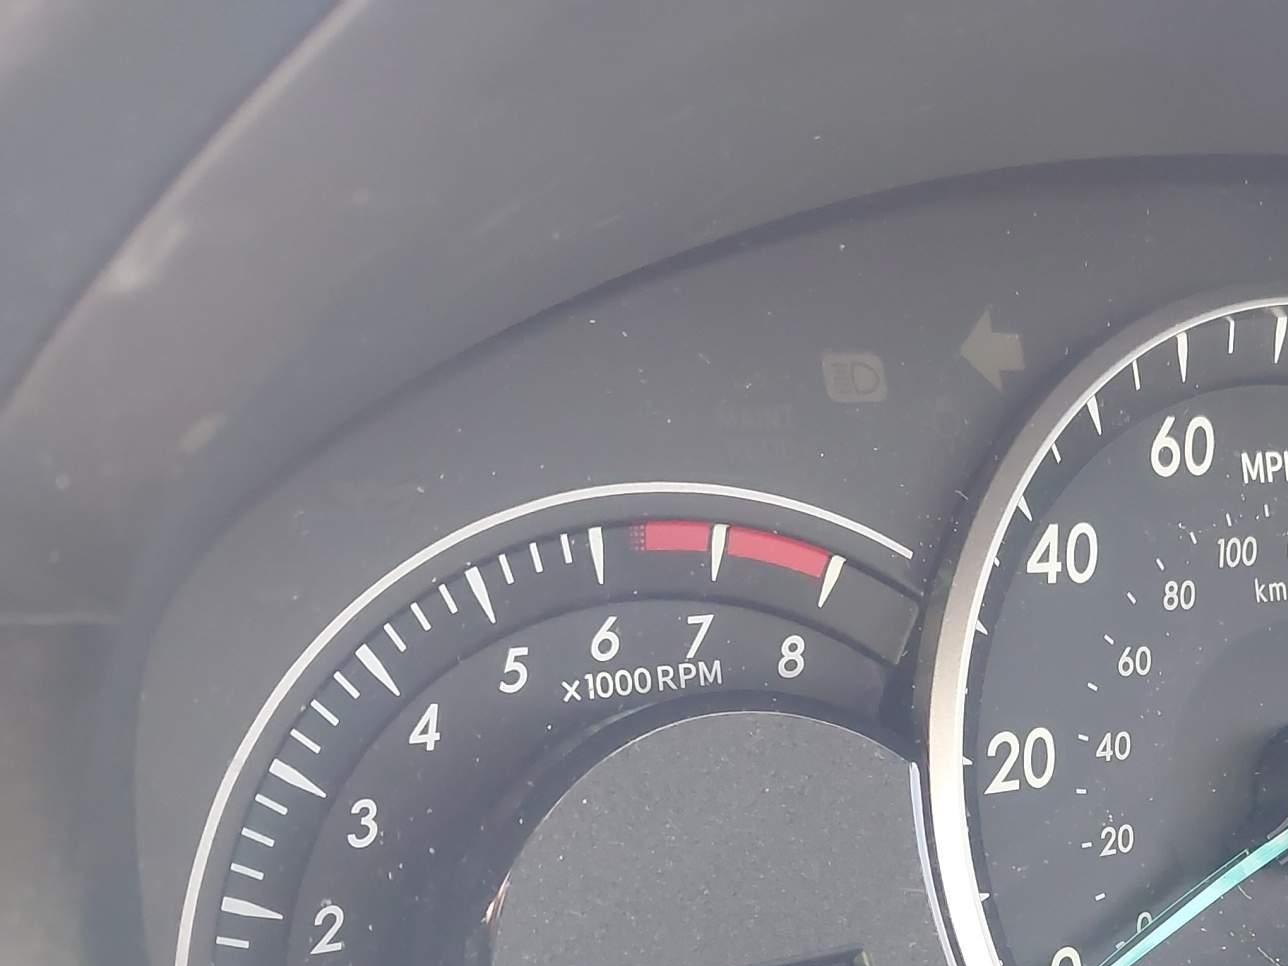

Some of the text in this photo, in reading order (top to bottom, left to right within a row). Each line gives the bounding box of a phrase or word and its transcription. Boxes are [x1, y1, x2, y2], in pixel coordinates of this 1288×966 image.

[1150, 415, 1215, 478] 60
[1026, 522, 1098, 584] 40
[1217, 535, 1258, 568] 100
[1162, 580, 1197, 611] 80
[590, 616, 621, 662] 6
[686, 614, 714, 659] 7
[777, 634, 806, 679] 8
[499, 646, 529, 694] 5
[1118, 645, 1152, 676] 60
[408, 703, 441, 751] 4
[1095, 731, 1131, 762] 40
[984, 727, 1056, 795] 20
[347, 798, 378, 848] 3
[1099, 823, 1134, 857] 20
[310, 904, 344, 955] 2
